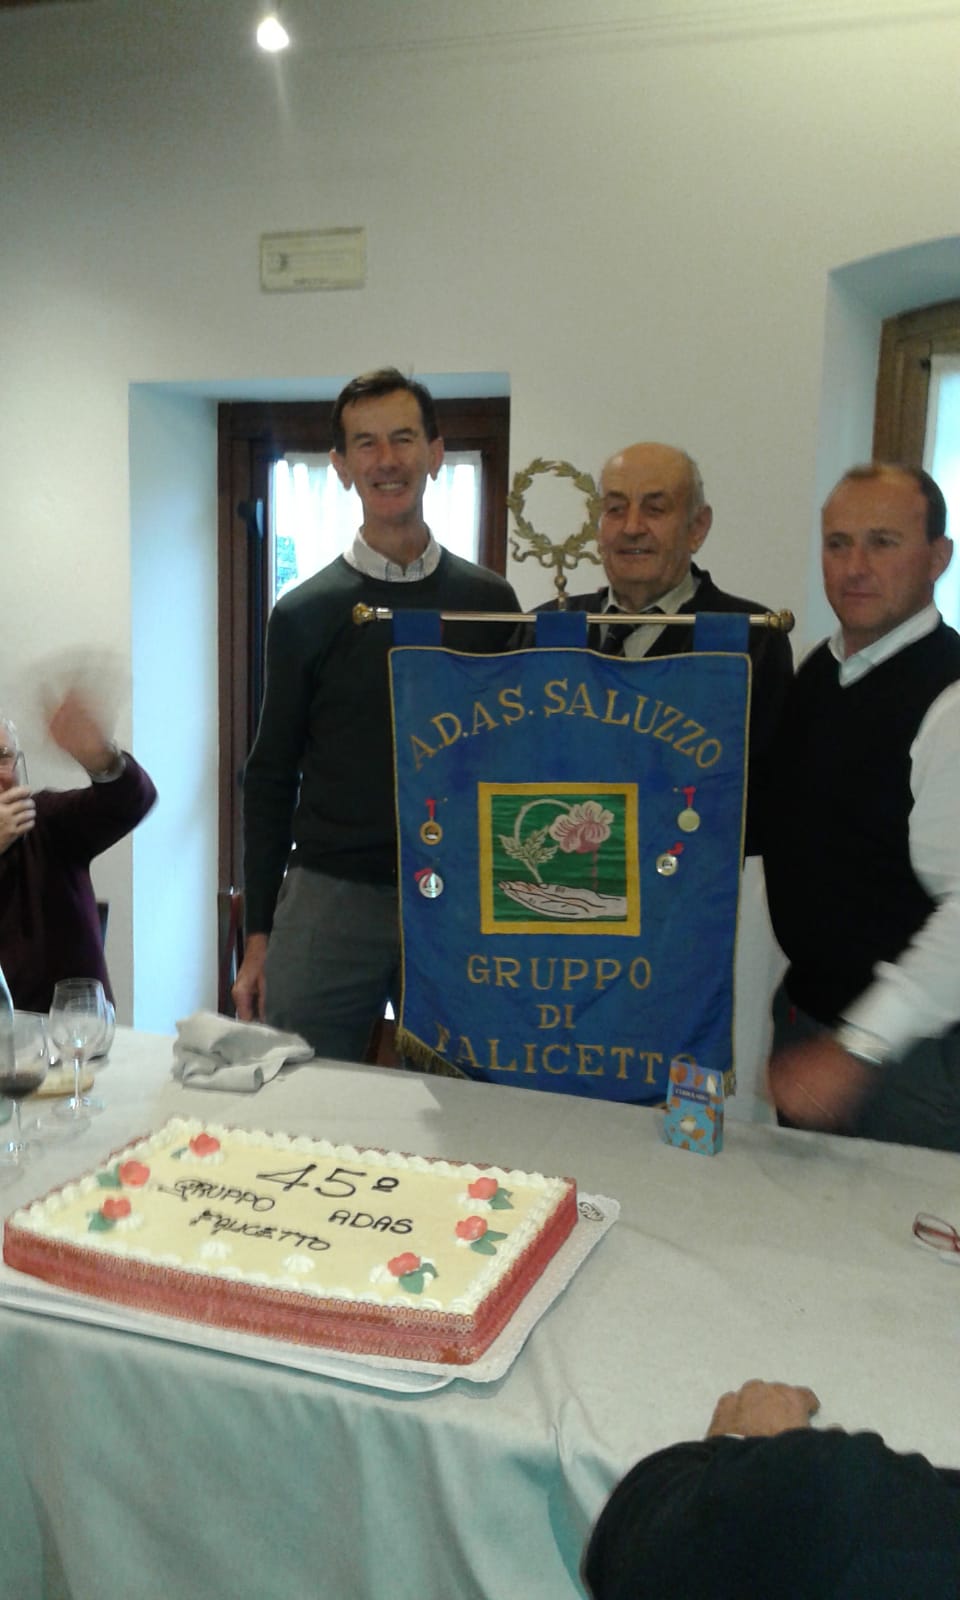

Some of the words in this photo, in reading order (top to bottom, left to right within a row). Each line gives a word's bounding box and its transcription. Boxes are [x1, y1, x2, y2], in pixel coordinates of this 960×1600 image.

[543, 678, 723, 768] SALUZZO
[466, 954, 651, 990] GRUPPO
[536, 1004, 576, 1029] DI
[158, 1179, 275, 1212] GRUPPO
[328, 1210, 413, 1234] ADAS
